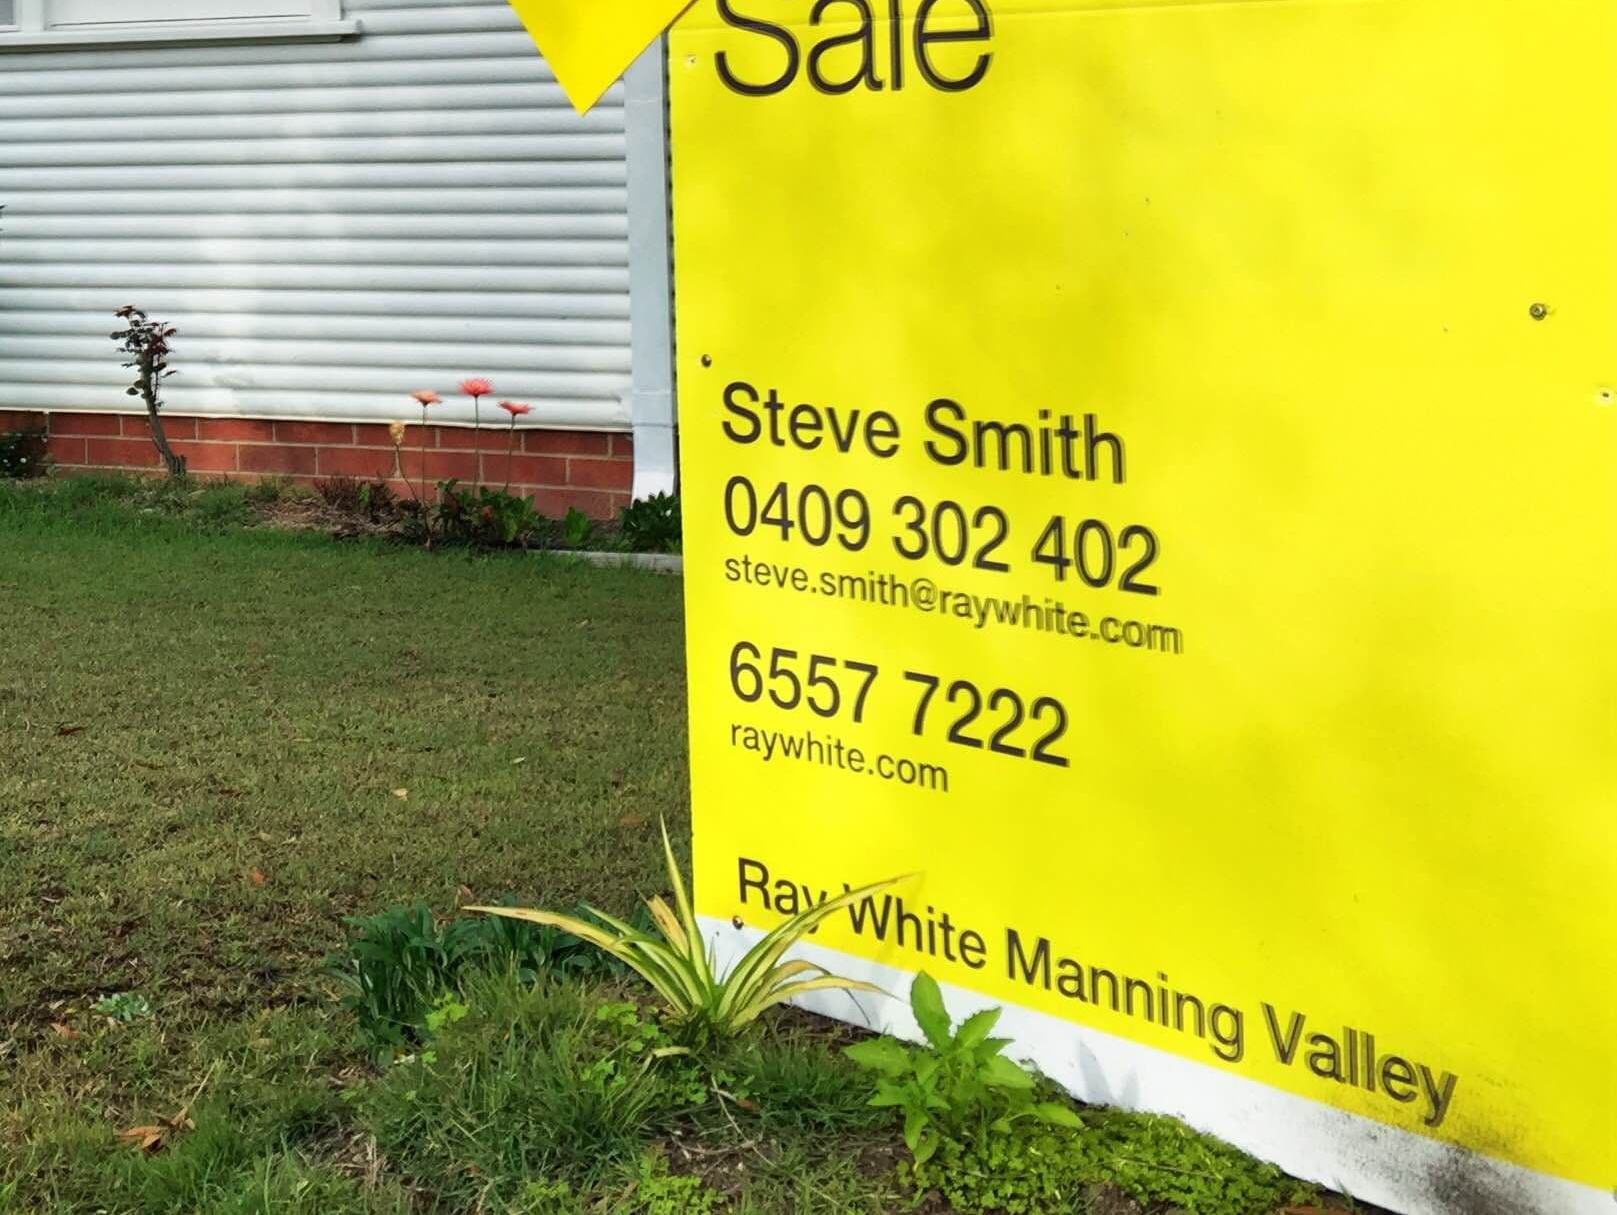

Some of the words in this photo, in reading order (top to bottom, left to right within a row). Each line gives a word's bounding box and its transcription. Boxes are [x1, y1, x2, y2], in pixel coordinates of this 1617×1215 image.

[721, 381, 900, 459] Steve
[924, 398, 1127, 485] Smith
[724, 475, 871, 552] 0409
[891, 495, 1011, 573] 302
[1030, 514, 1161, 597] 402
[725, 554, 1185, 655] steve.smith@raywhite.com
[729, 640, 879, 724] 6557
[903, 670, 1070, 768] 7222
[731, 721, 949, 793] raywhite.com
[737, 857, 827, 935] Ray
[844, 883, 988, 970] White
[1005, 927, 1245, 1063] Manning
[1262, 1001, 1459, 1128] Valley
